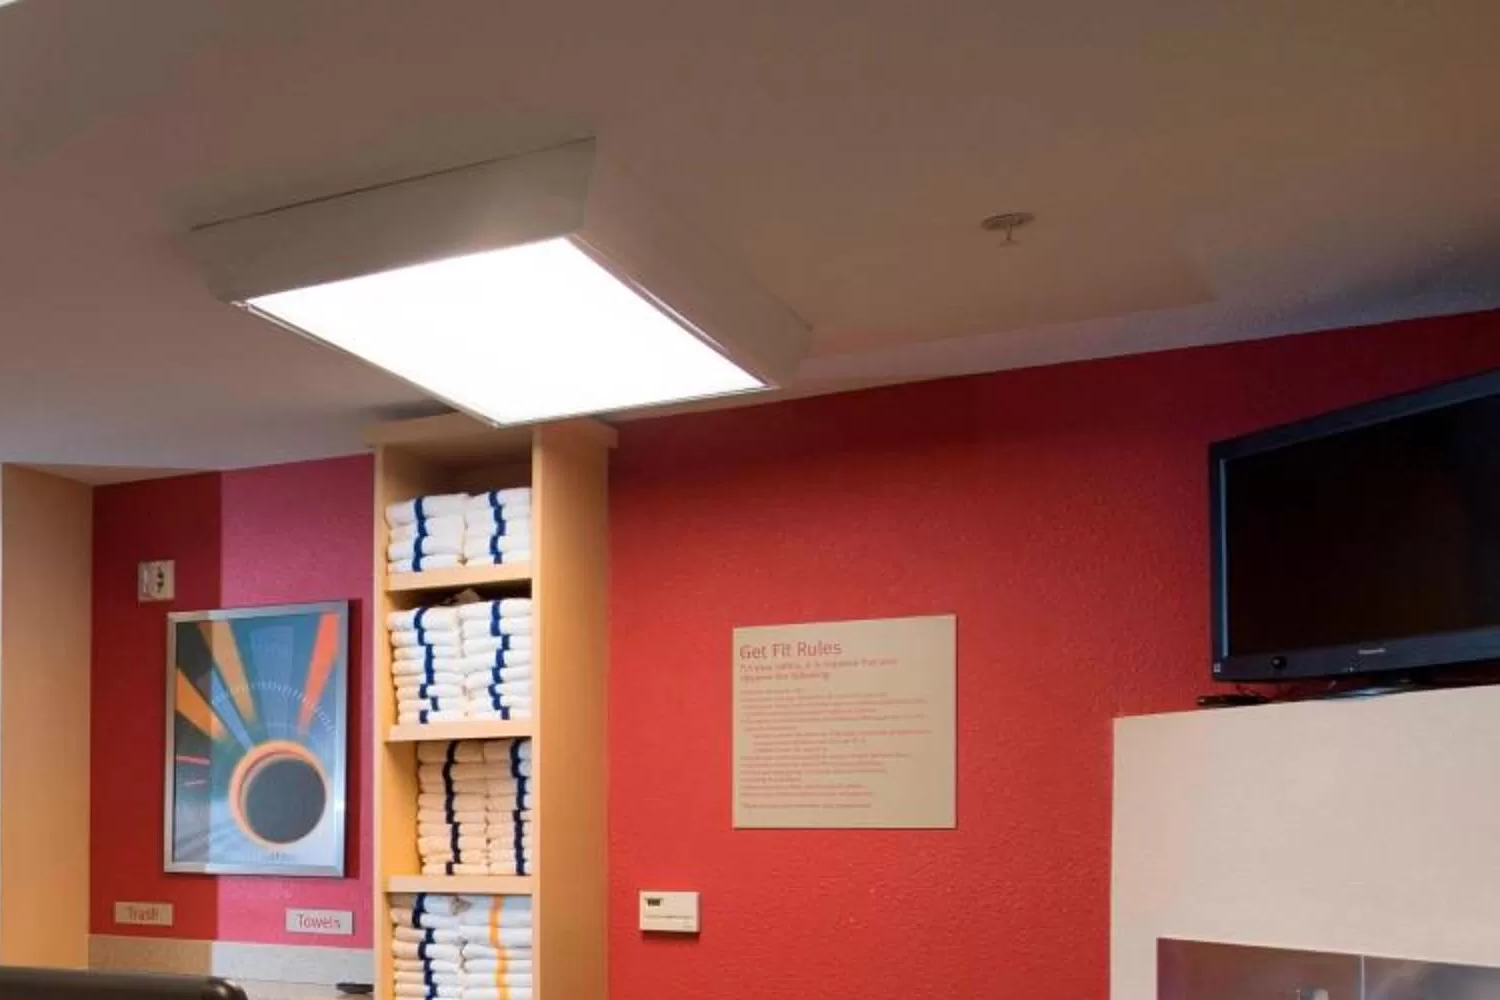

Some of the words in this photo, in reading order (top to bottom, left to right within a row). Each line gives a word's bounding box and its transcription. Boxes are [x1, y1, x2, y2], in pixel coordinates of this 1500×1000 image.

[740, 644, 768, 660] Get
[772, 642, 792, 657] Fit
[797, 640, 843, 657] Rules
[295, 913, 341, 929] Towels
